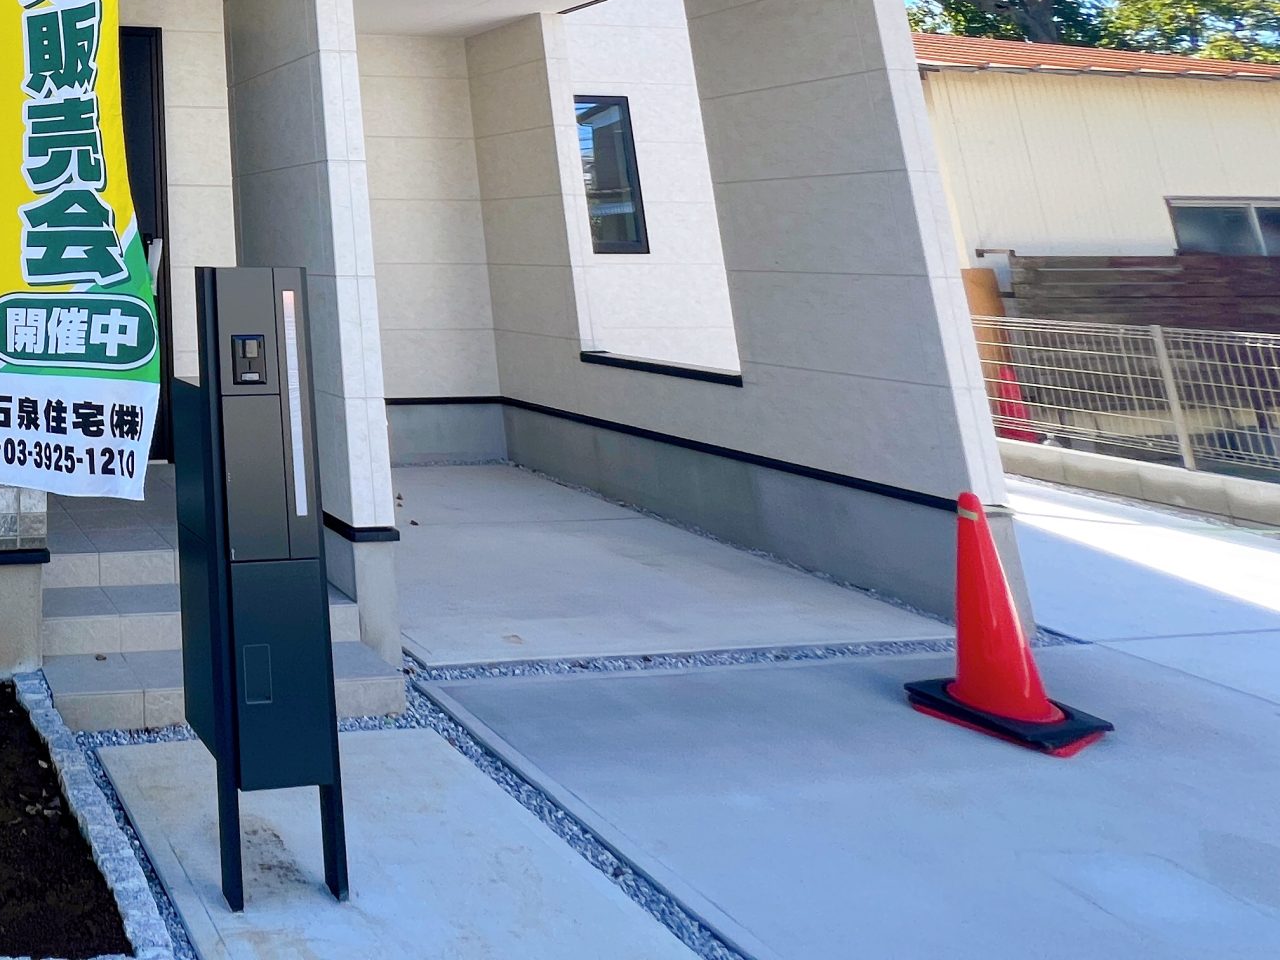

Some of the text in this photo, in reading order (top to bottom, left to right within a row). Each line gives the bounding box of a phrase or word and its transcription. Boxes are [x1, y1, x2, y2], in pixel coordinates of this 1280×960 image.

[6, 307, 140, 357] 開催中
[3, 437, 136, 479] 03-3925-1210
